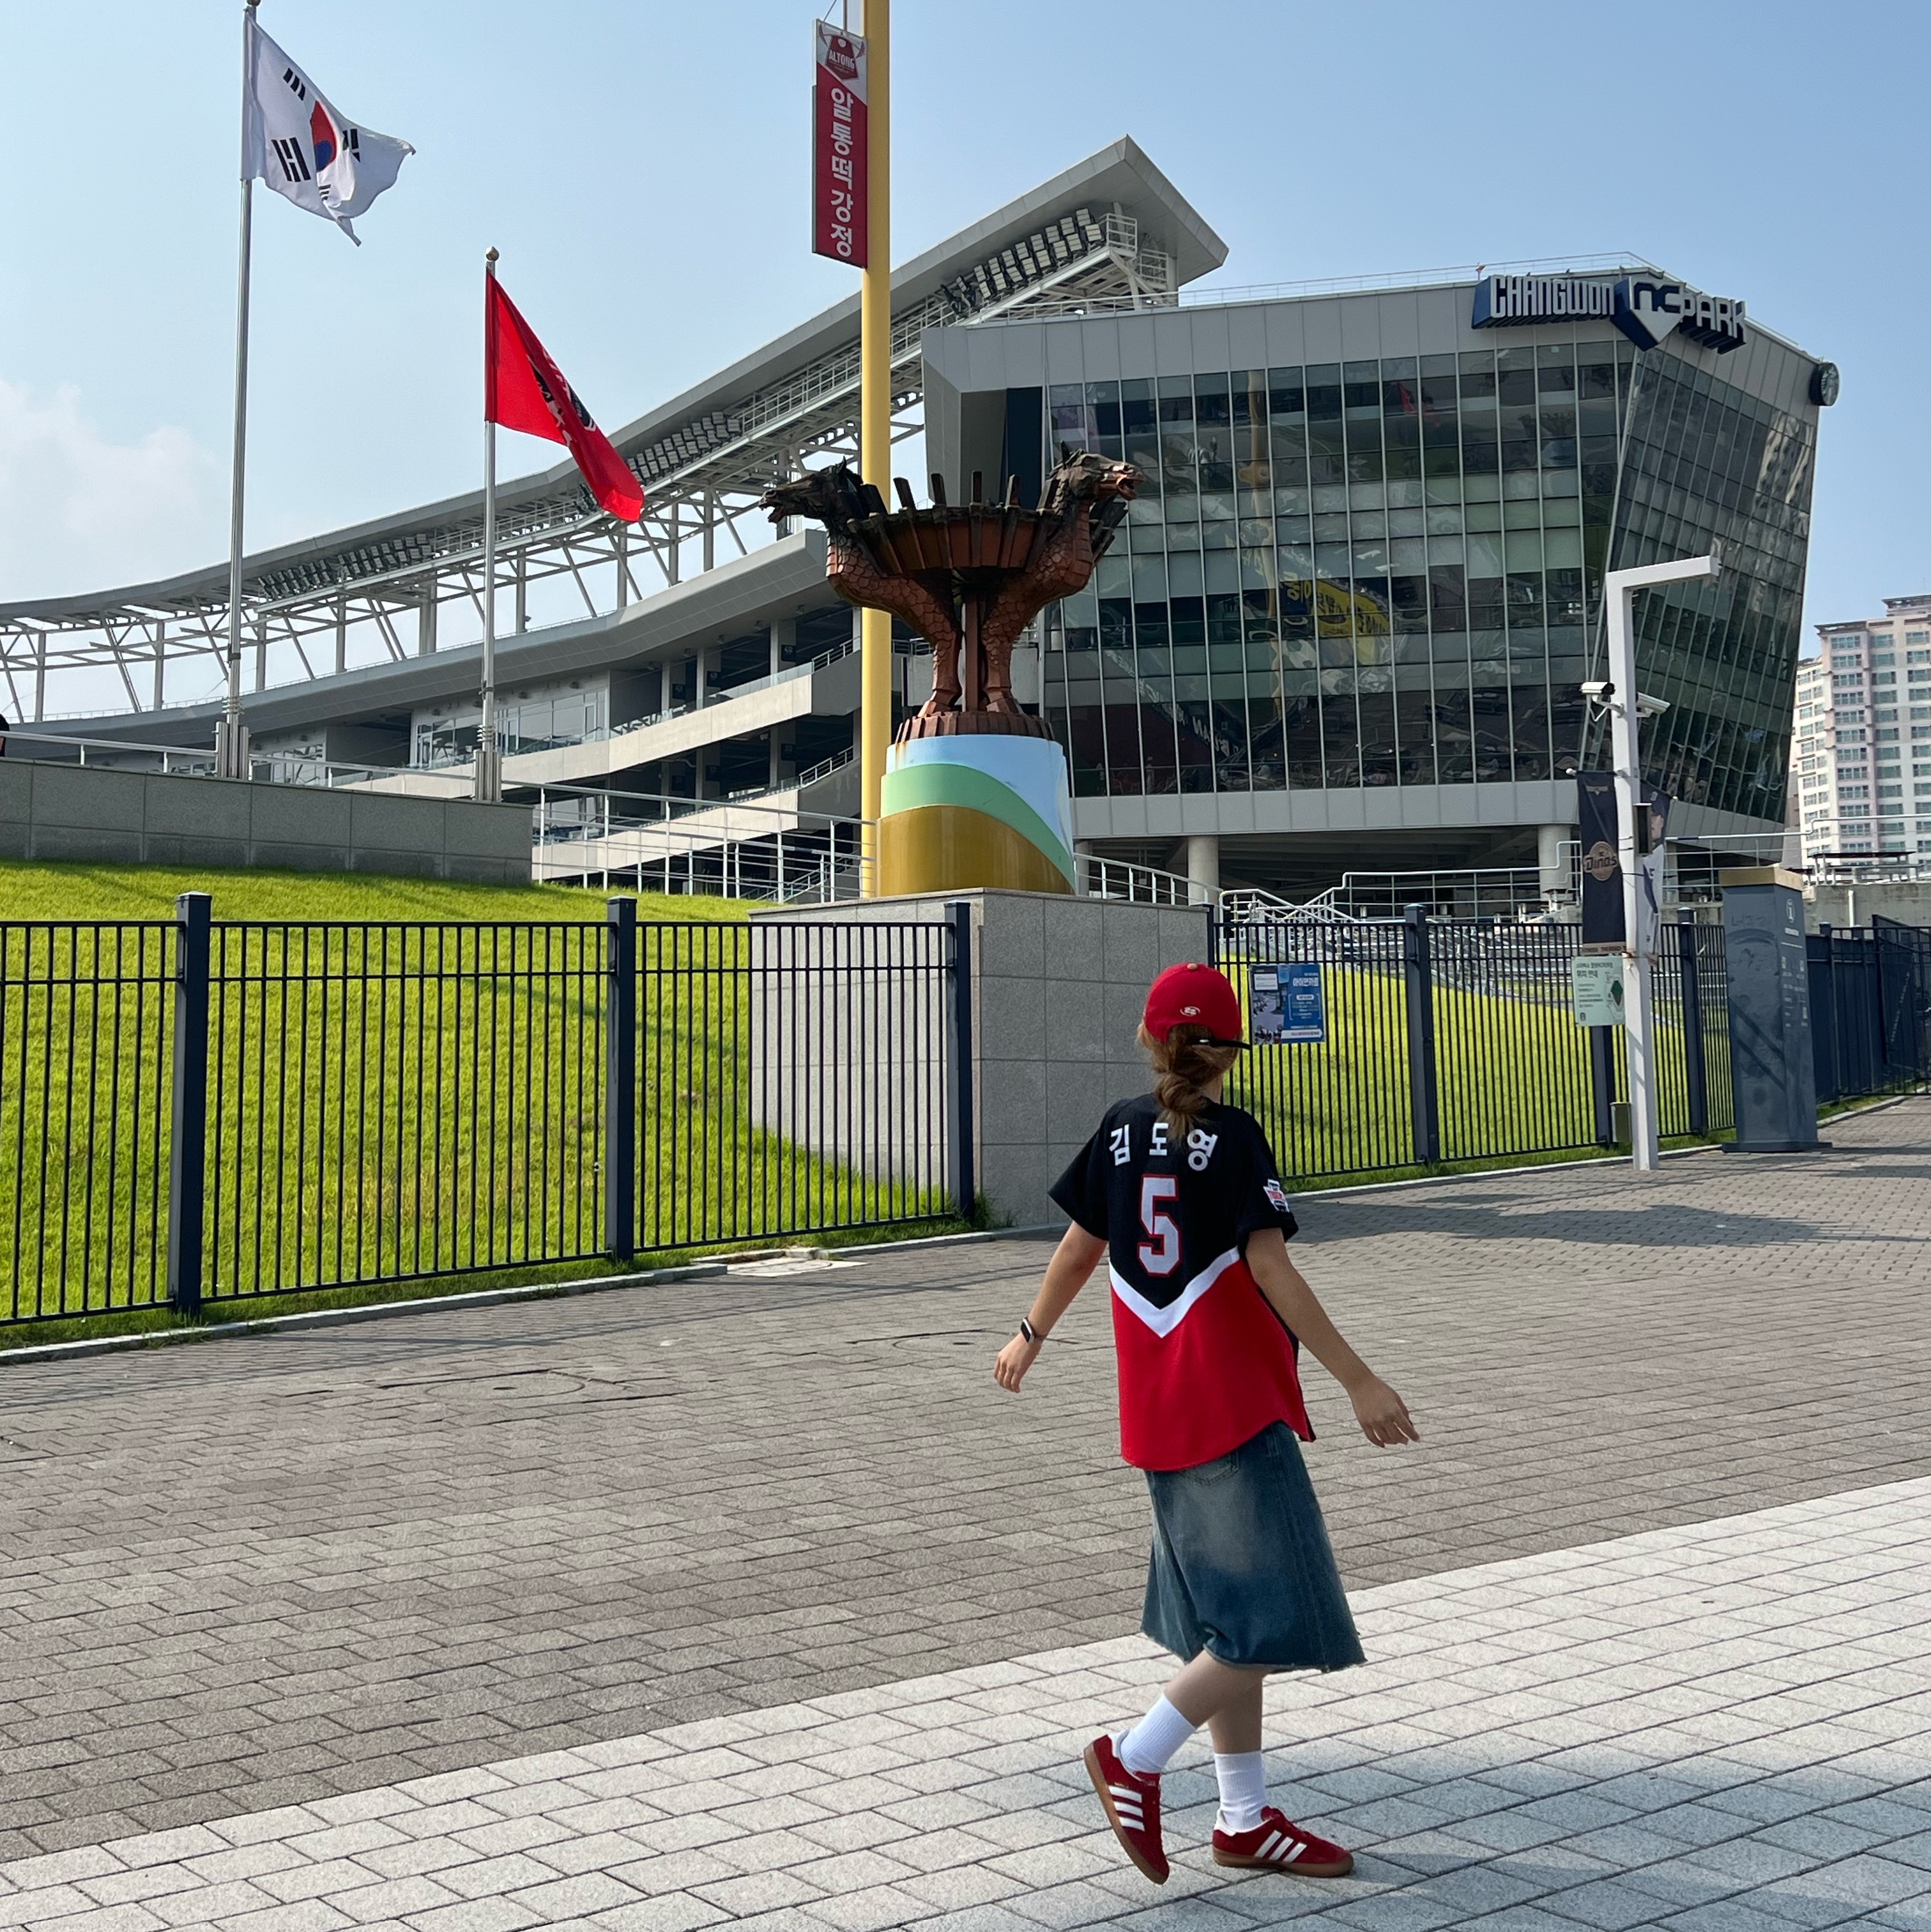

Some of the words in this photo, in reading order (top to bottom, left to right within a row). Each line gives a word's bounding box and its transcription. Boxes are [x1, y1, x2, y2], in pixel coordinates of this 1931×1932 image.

[830, 87, 853, 257] 알통떡강정
[1489, 275, 1615, 318] CHANGWON
[1681, 294, 1746, 344] PARK
[1585, 855, 1617, 871] Dinos
[1109, 1122, 1218, 1171] 김도영
[1137, 1173, 1182, 1277] 5
